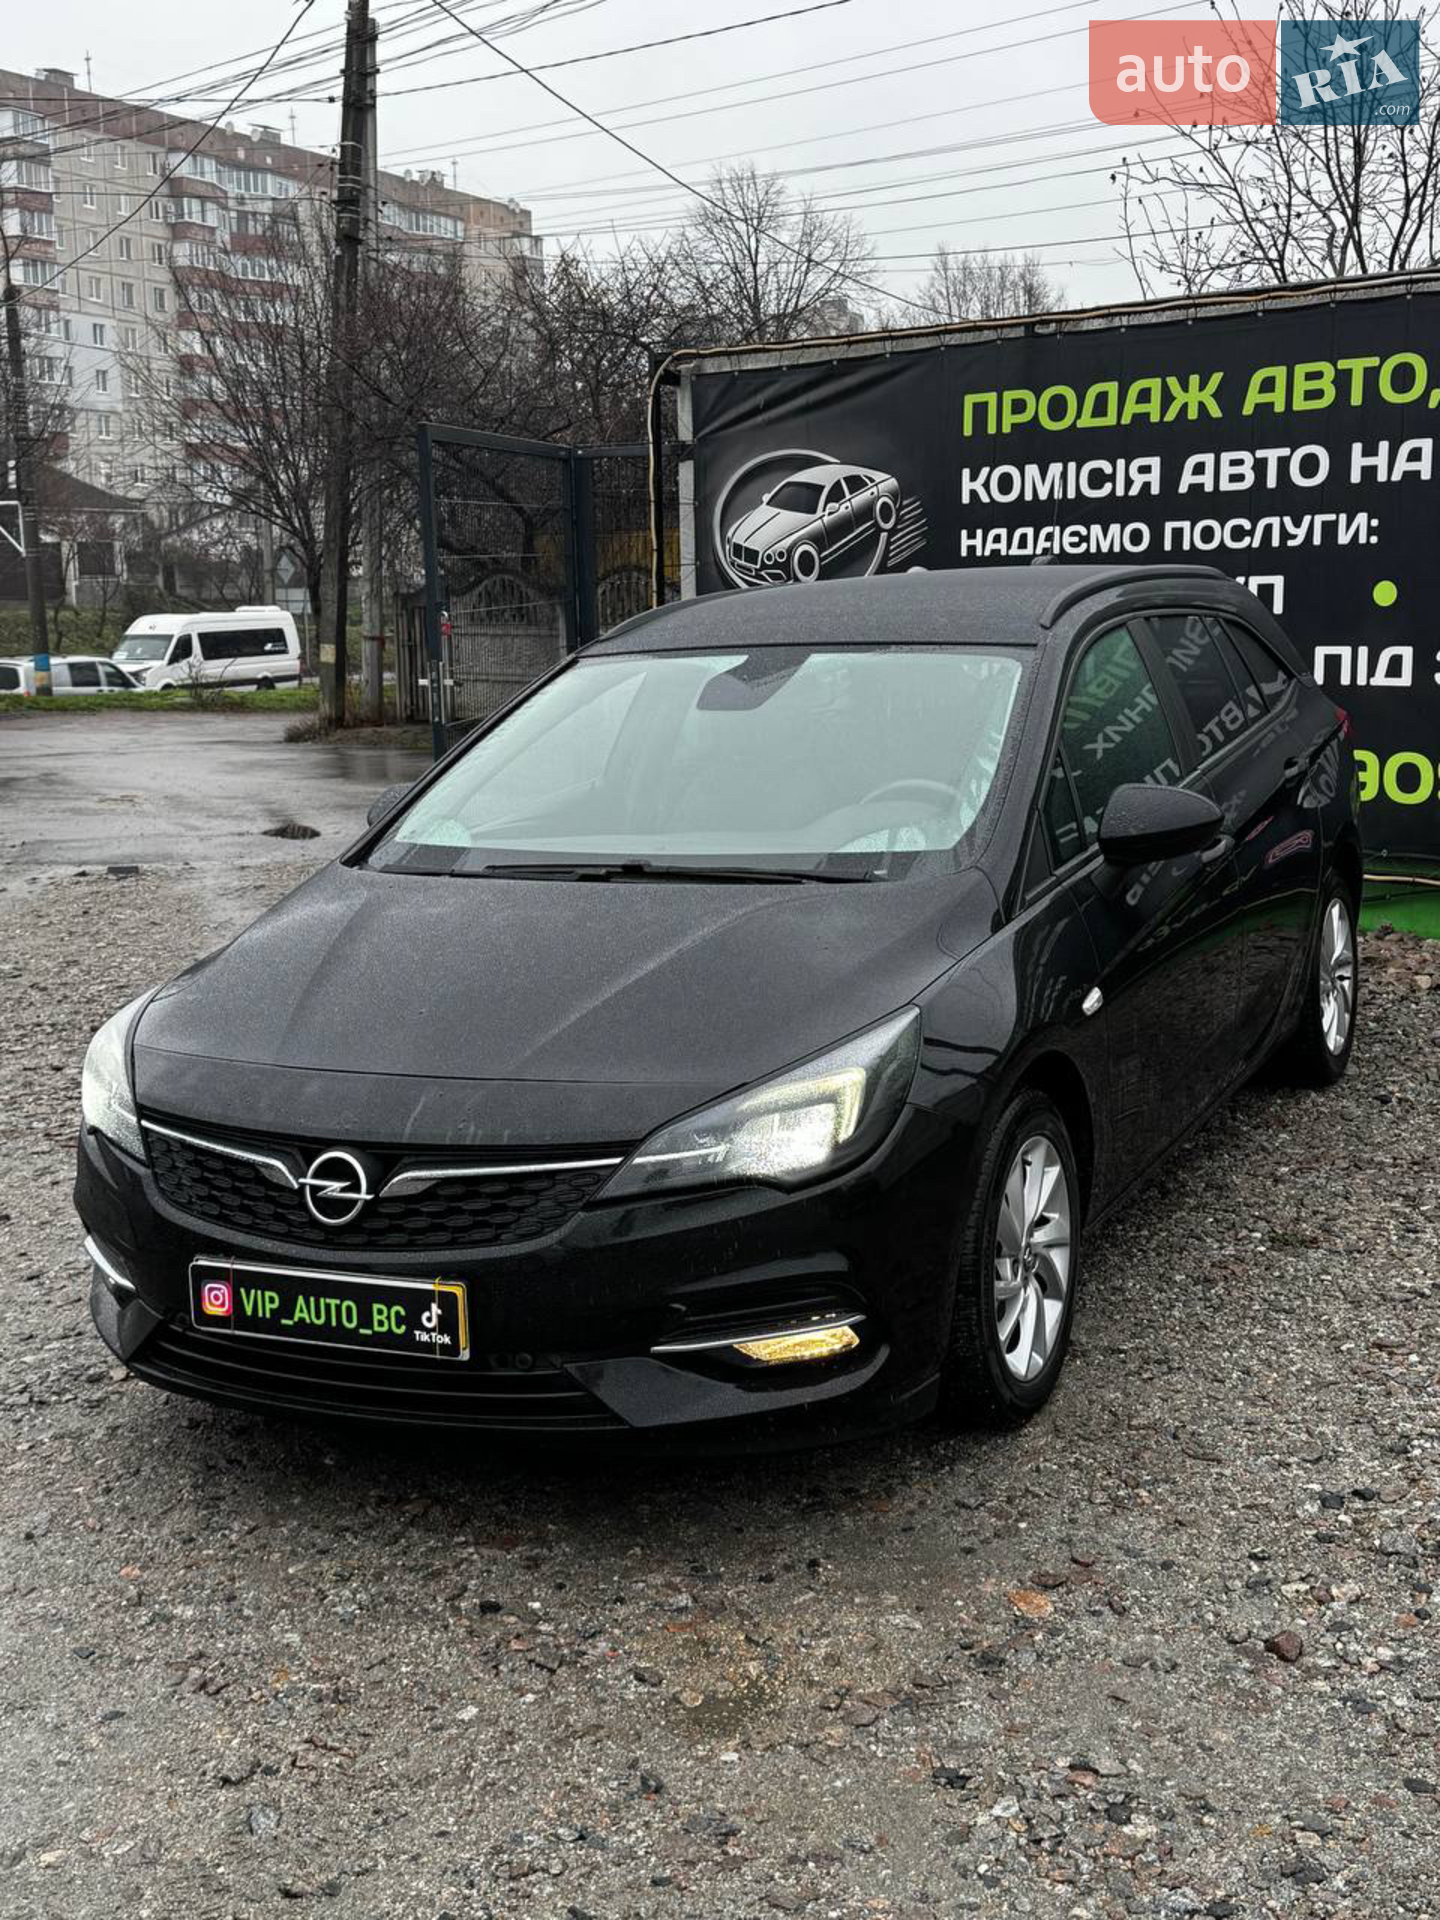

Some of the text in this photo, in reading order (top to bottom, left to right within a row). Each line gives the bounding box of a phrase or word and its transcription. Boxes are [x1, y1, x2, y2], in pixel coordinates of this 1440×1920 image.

[963, 371, 1224, 437] ПРОДАЖ
[961, 437, 1434, 505] КОМІСІЯ АВТО НА
[960, 512, 1379, 557] НАДАЄМО ПОСЛУГИ:
[1313, 645, 1414, 687] ПІД
[240, 1287, 407, 1335] VIP_AUTO_BC
[413, 1330, 452, 1345] TikTok
